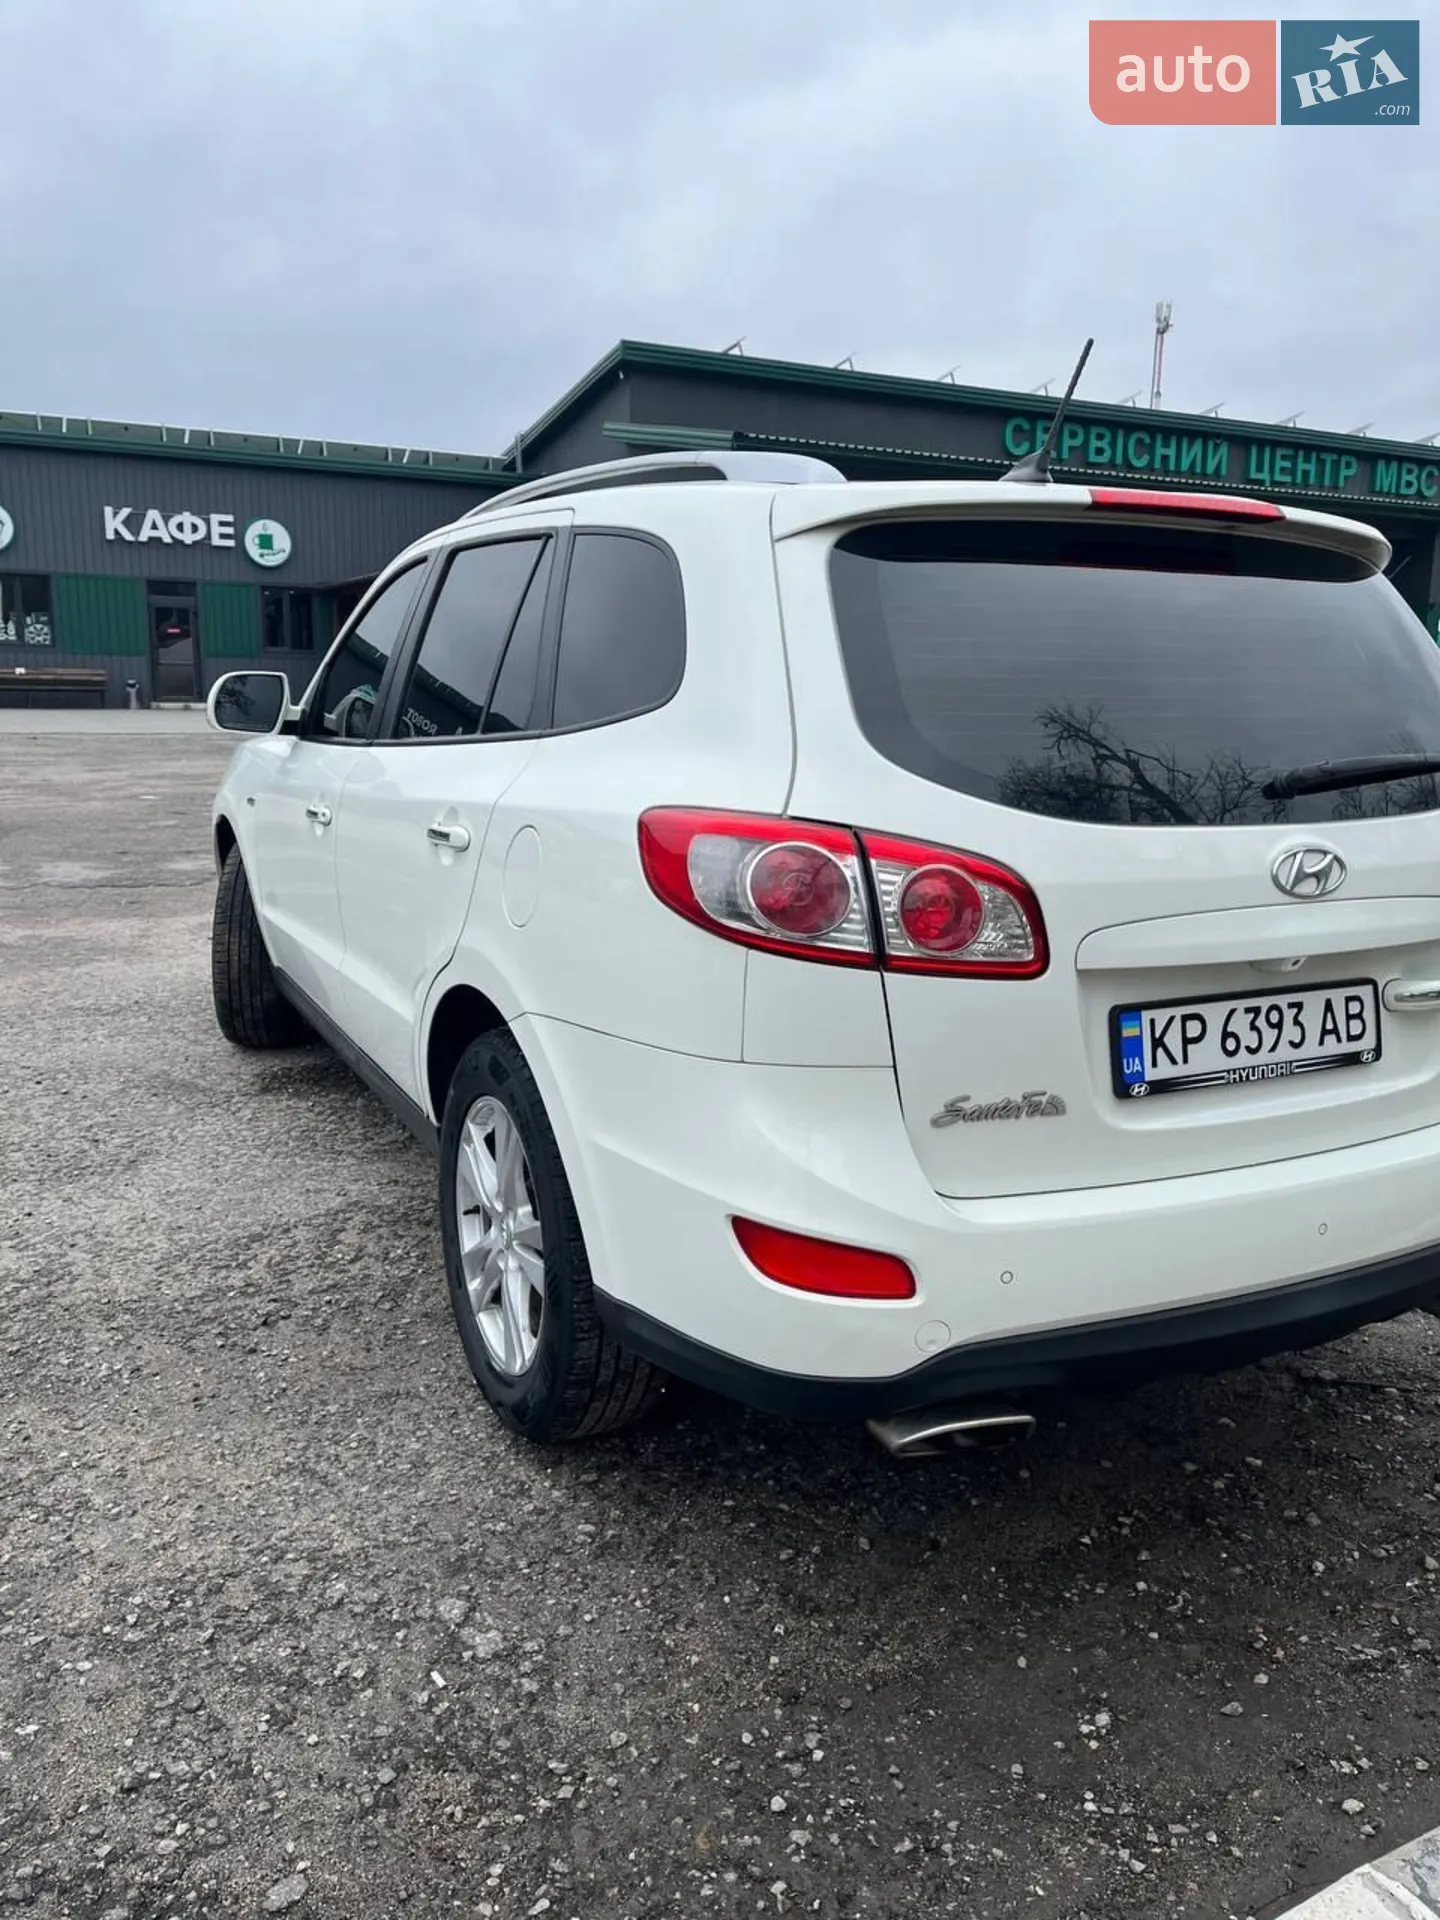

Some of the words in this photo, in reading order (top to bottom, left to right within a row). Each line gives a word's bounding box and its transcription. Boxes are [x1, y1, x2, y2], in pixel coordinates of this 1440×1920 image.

[1248, 444, 1358, 488] ЦЕНТР
[1375, 459, 1440, 498] МВС
[103, 505, 235, 548] КАФЕ
[1149, 1012, 1207, 1069] KP
[1220, 1000, 1307, 1058] 6393
[1317, 994, 1367, 1046] AB
[1123, 1060, 1142, 1075] UA
[1228, 1062, 1292, 1084] HYUNDAI
